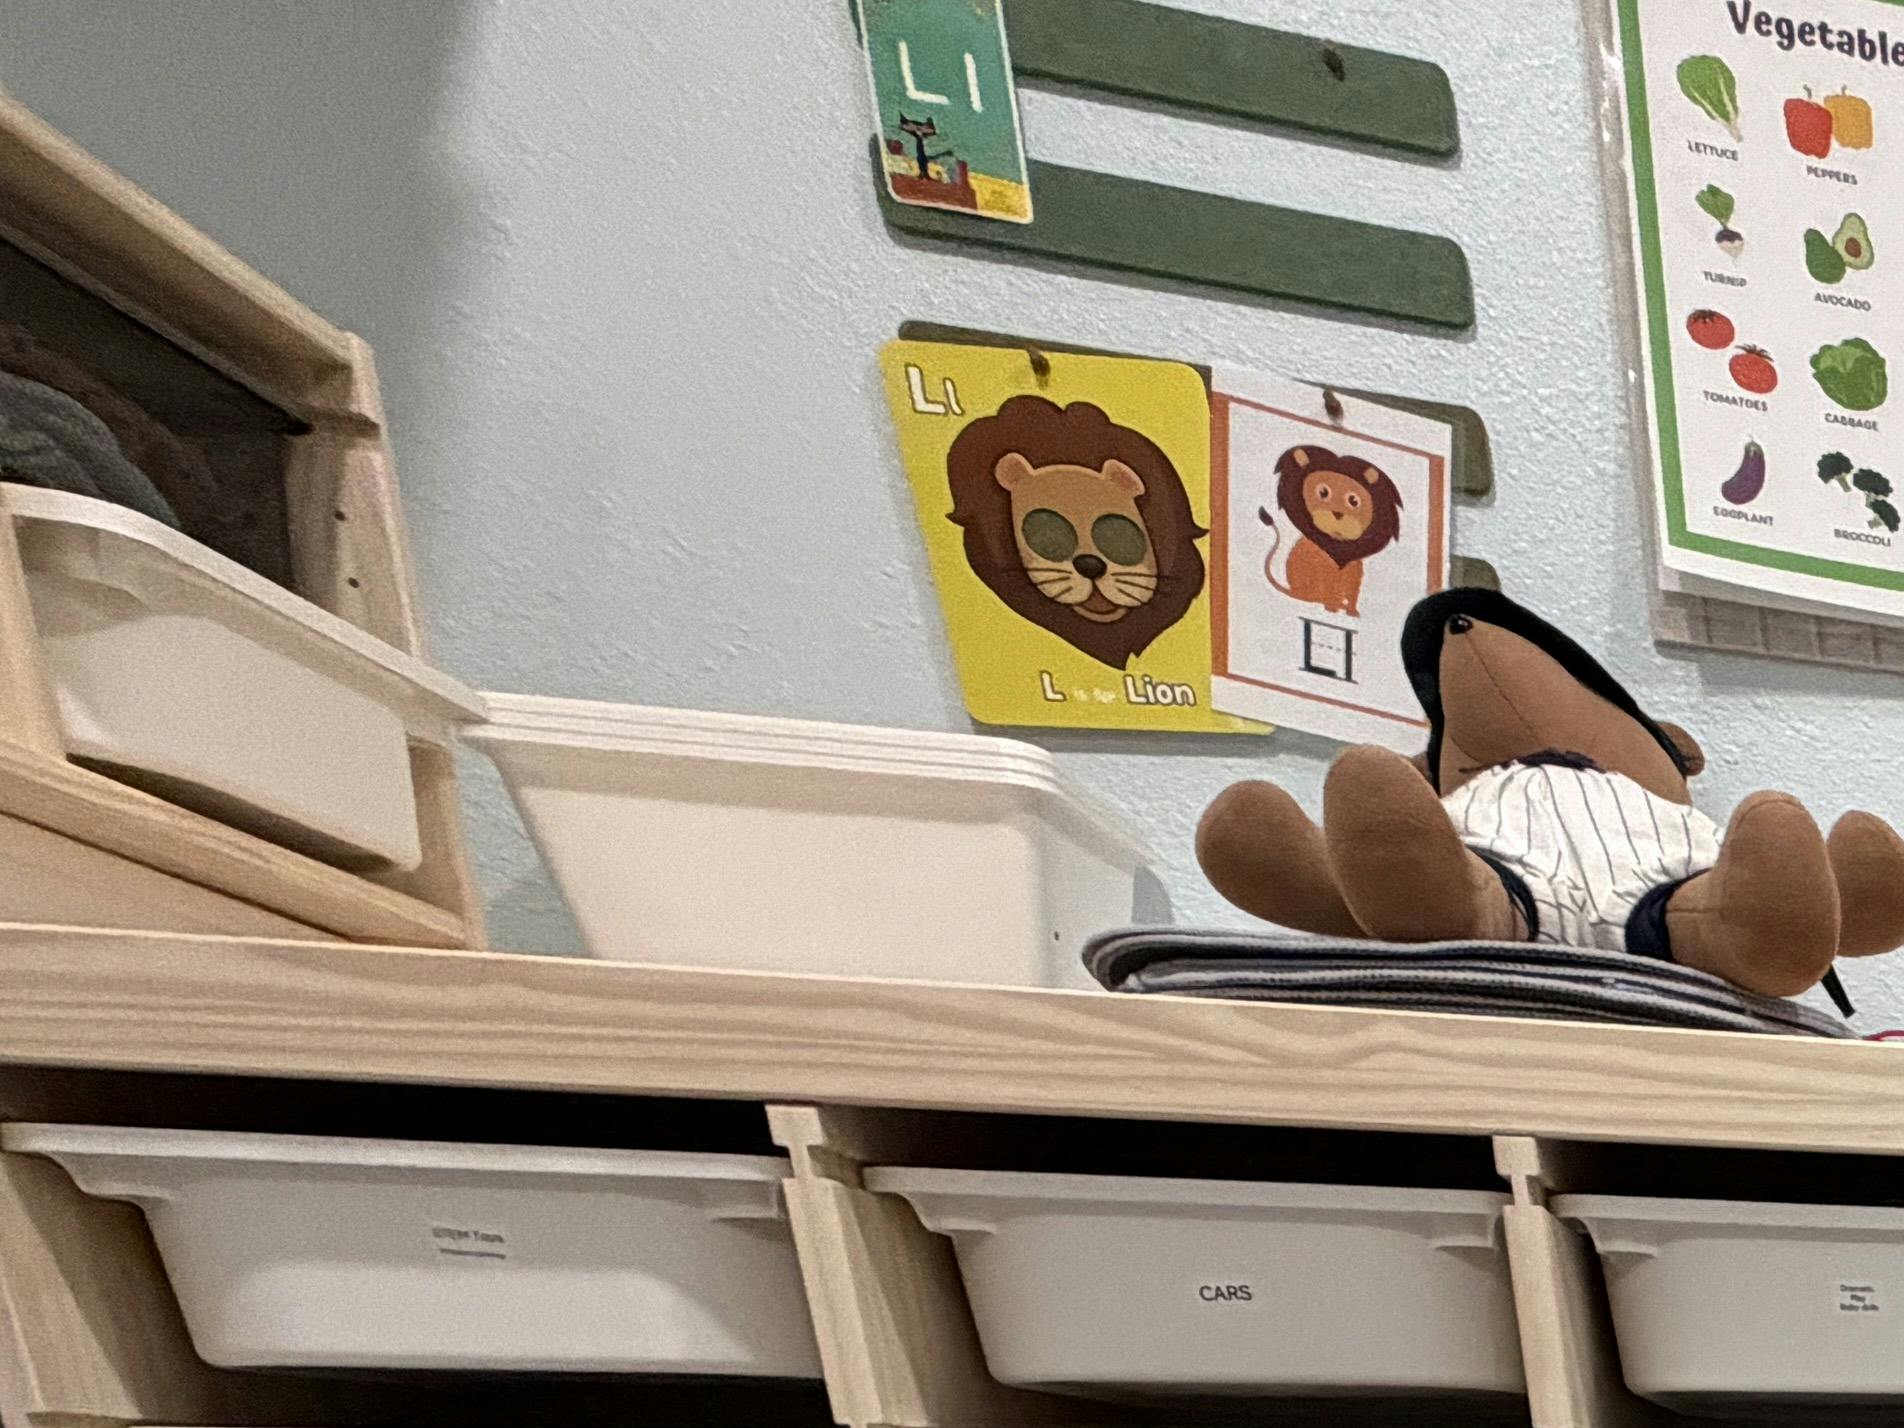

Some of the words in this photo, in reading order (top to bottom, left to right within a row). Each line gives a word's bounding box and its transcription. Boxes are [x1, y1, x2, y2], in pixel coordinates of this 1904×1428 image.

[1687, 140, 1739, 163] LETTUCE
[1806, 165, 1858, 186] PEPPERS
[1815, 292, 1871, 312] AVOCADO
[1703, 390, 1768, 412] TOMATOES
[1825, 413, 1879, 431] CABBAGE
[1713, 506, 1774, 526] EGGPLANT
[1834, 529, 1891, 548] BROCCOLI
[1124, 675, 1198, 706] Lion
[1199, 1285, 1252, 1301] CARS
